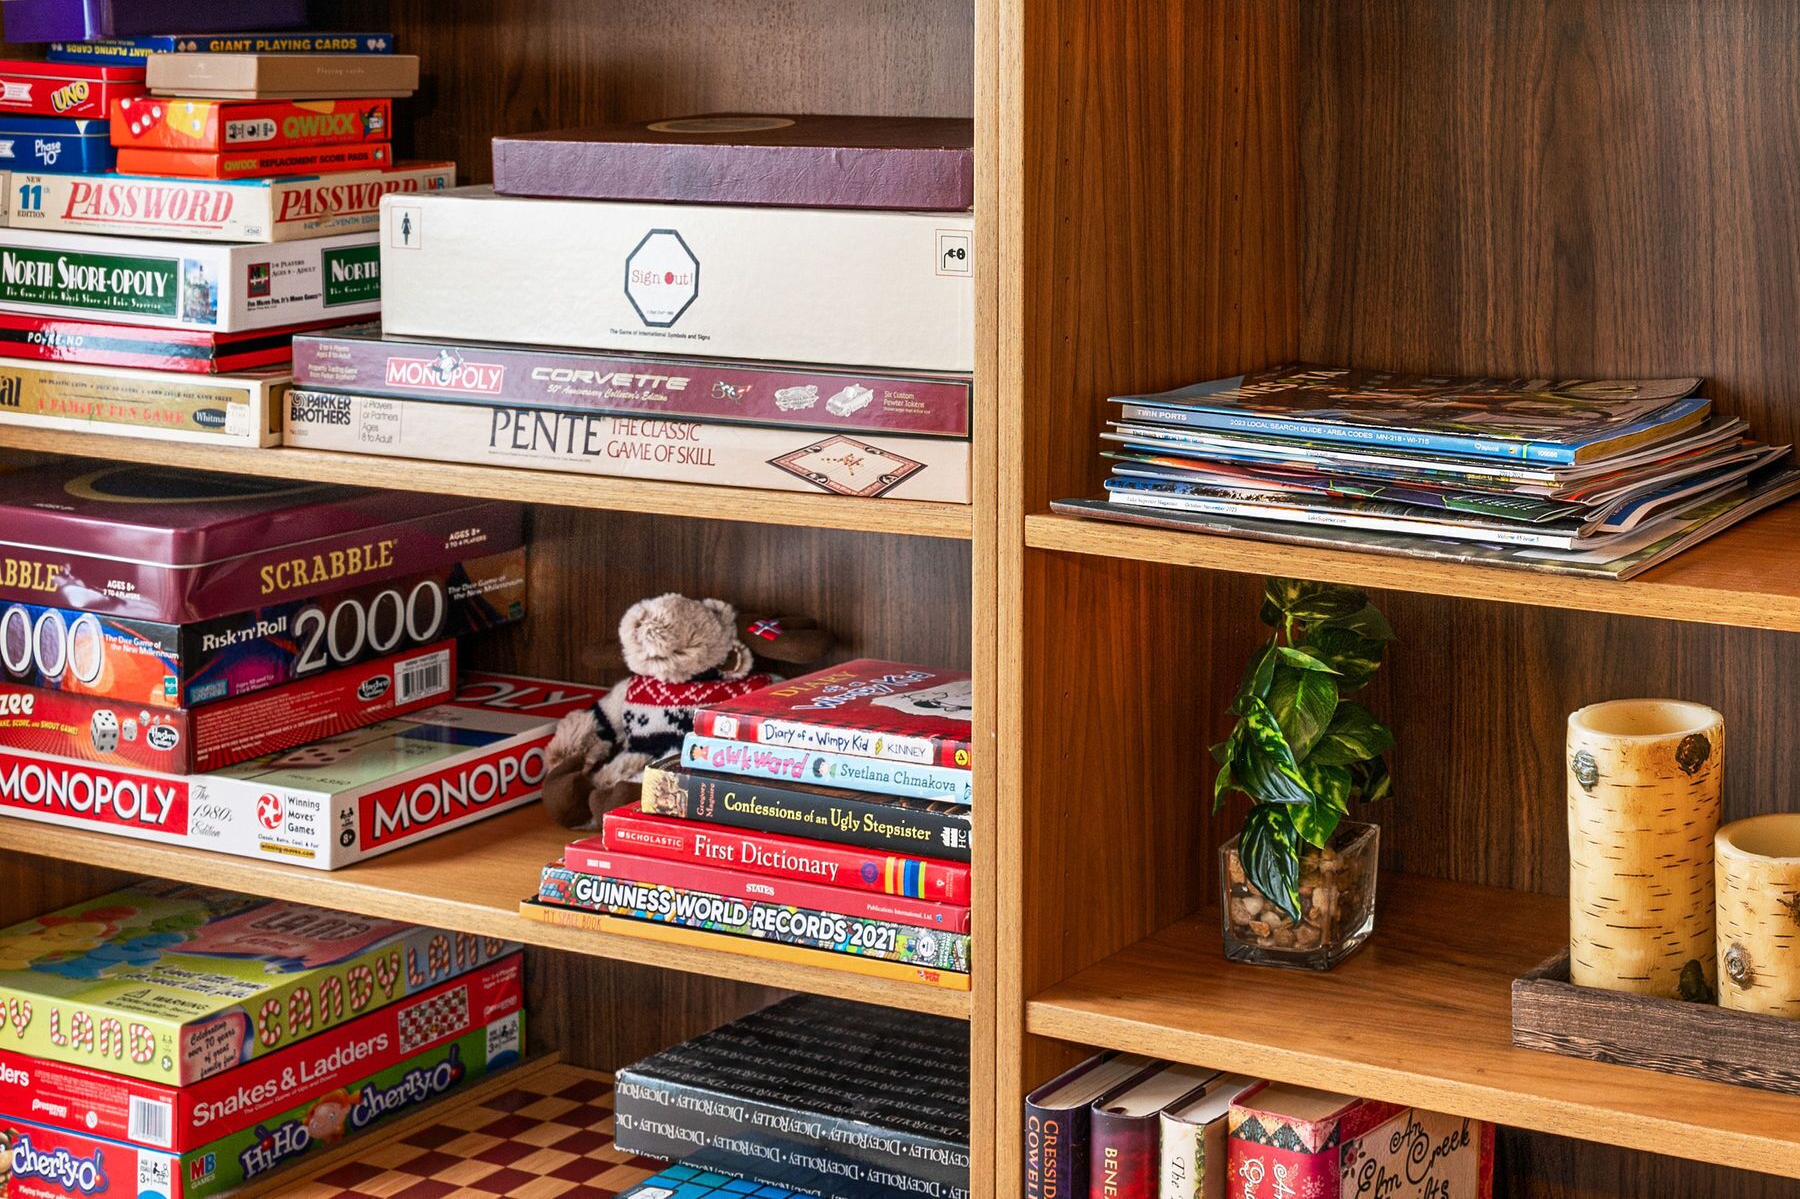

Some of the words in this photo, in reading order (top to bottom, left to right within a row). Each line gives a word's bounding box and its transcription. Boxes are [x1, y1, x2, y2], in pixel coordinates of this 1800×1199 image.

[209, 39, 251, 51] GIANT
[256, 38, 311, 50] PLAYING
[315, 38, 357, 50] CARDS
[51, 80, 90, 114] UNO
[282, 113, 354, 138] QWIXX
[61, 181, 233, 224] PASSWORD
[2, 251, 53, 287] NORTH
[58, 256, 168, 297] SHORE-OPOLY
[632, 269, 661, 286] Sign
[664, 271, 693, 286] Out!
[388, 362, 501, 389] MONOPOLY
[531, 367, 691, 391] CORVETTE
[307, 395, 352, 409] PARKER
[290, 407, 351, 425] BROTHERS
[1137, 409, 1157, 418] TWIN
[1158, 412, 1187, 421] PORTS
[1247, 420, 1269, 429] LOCAL
[1270, 423, 1299, 431] SEARCH
[1300, 426, 1322, 434] GUIDE
[489, 409, 602, 456] PENTE
[613, 418, 638, 436] THE
[640, 421, 701, 441] CLASSIC
[607, 440, 652, 460] GAME
[654, 445, 674, 462] OF
[677, 447, 715, 466] SKILL
[260, 540, 396, 594] SCRABBLE
[294, 580, 444, 674] 2000
[764, 722, 796, 744] Diary
[798, 730, 806, 740] of
[816, 730, 850, 753] Wimpy
[852, 732, 869, 752] Kid
[887, 742, 926, 758] KINNEY
[840, 763, 891, 784] Svetlana
[894, 767, 956, 792] Chmakova
[0, 763, 175, 825] MONOPOLY
[288, 797, 320, 811] Winning
[288, 812, 314, 822] Moves
[288, 824, 315, 835] Games
[625, 831, 682, 847] SCHOLASTIC
[694, 835, 734, 862] First
[740, 842, 840, 881] Dictionary
[574, 880, 673, 919] GUINNESS
[674, 894, 749, 927] WORLD
[750, 904, 848, 944] RECORDS
[849, 922, 896, 951] 2021
[192, 1078, 278, 1127] Snakes
[280, 1067, 296, 1091] &
[300, 1033, 389, 1084] Ladders
